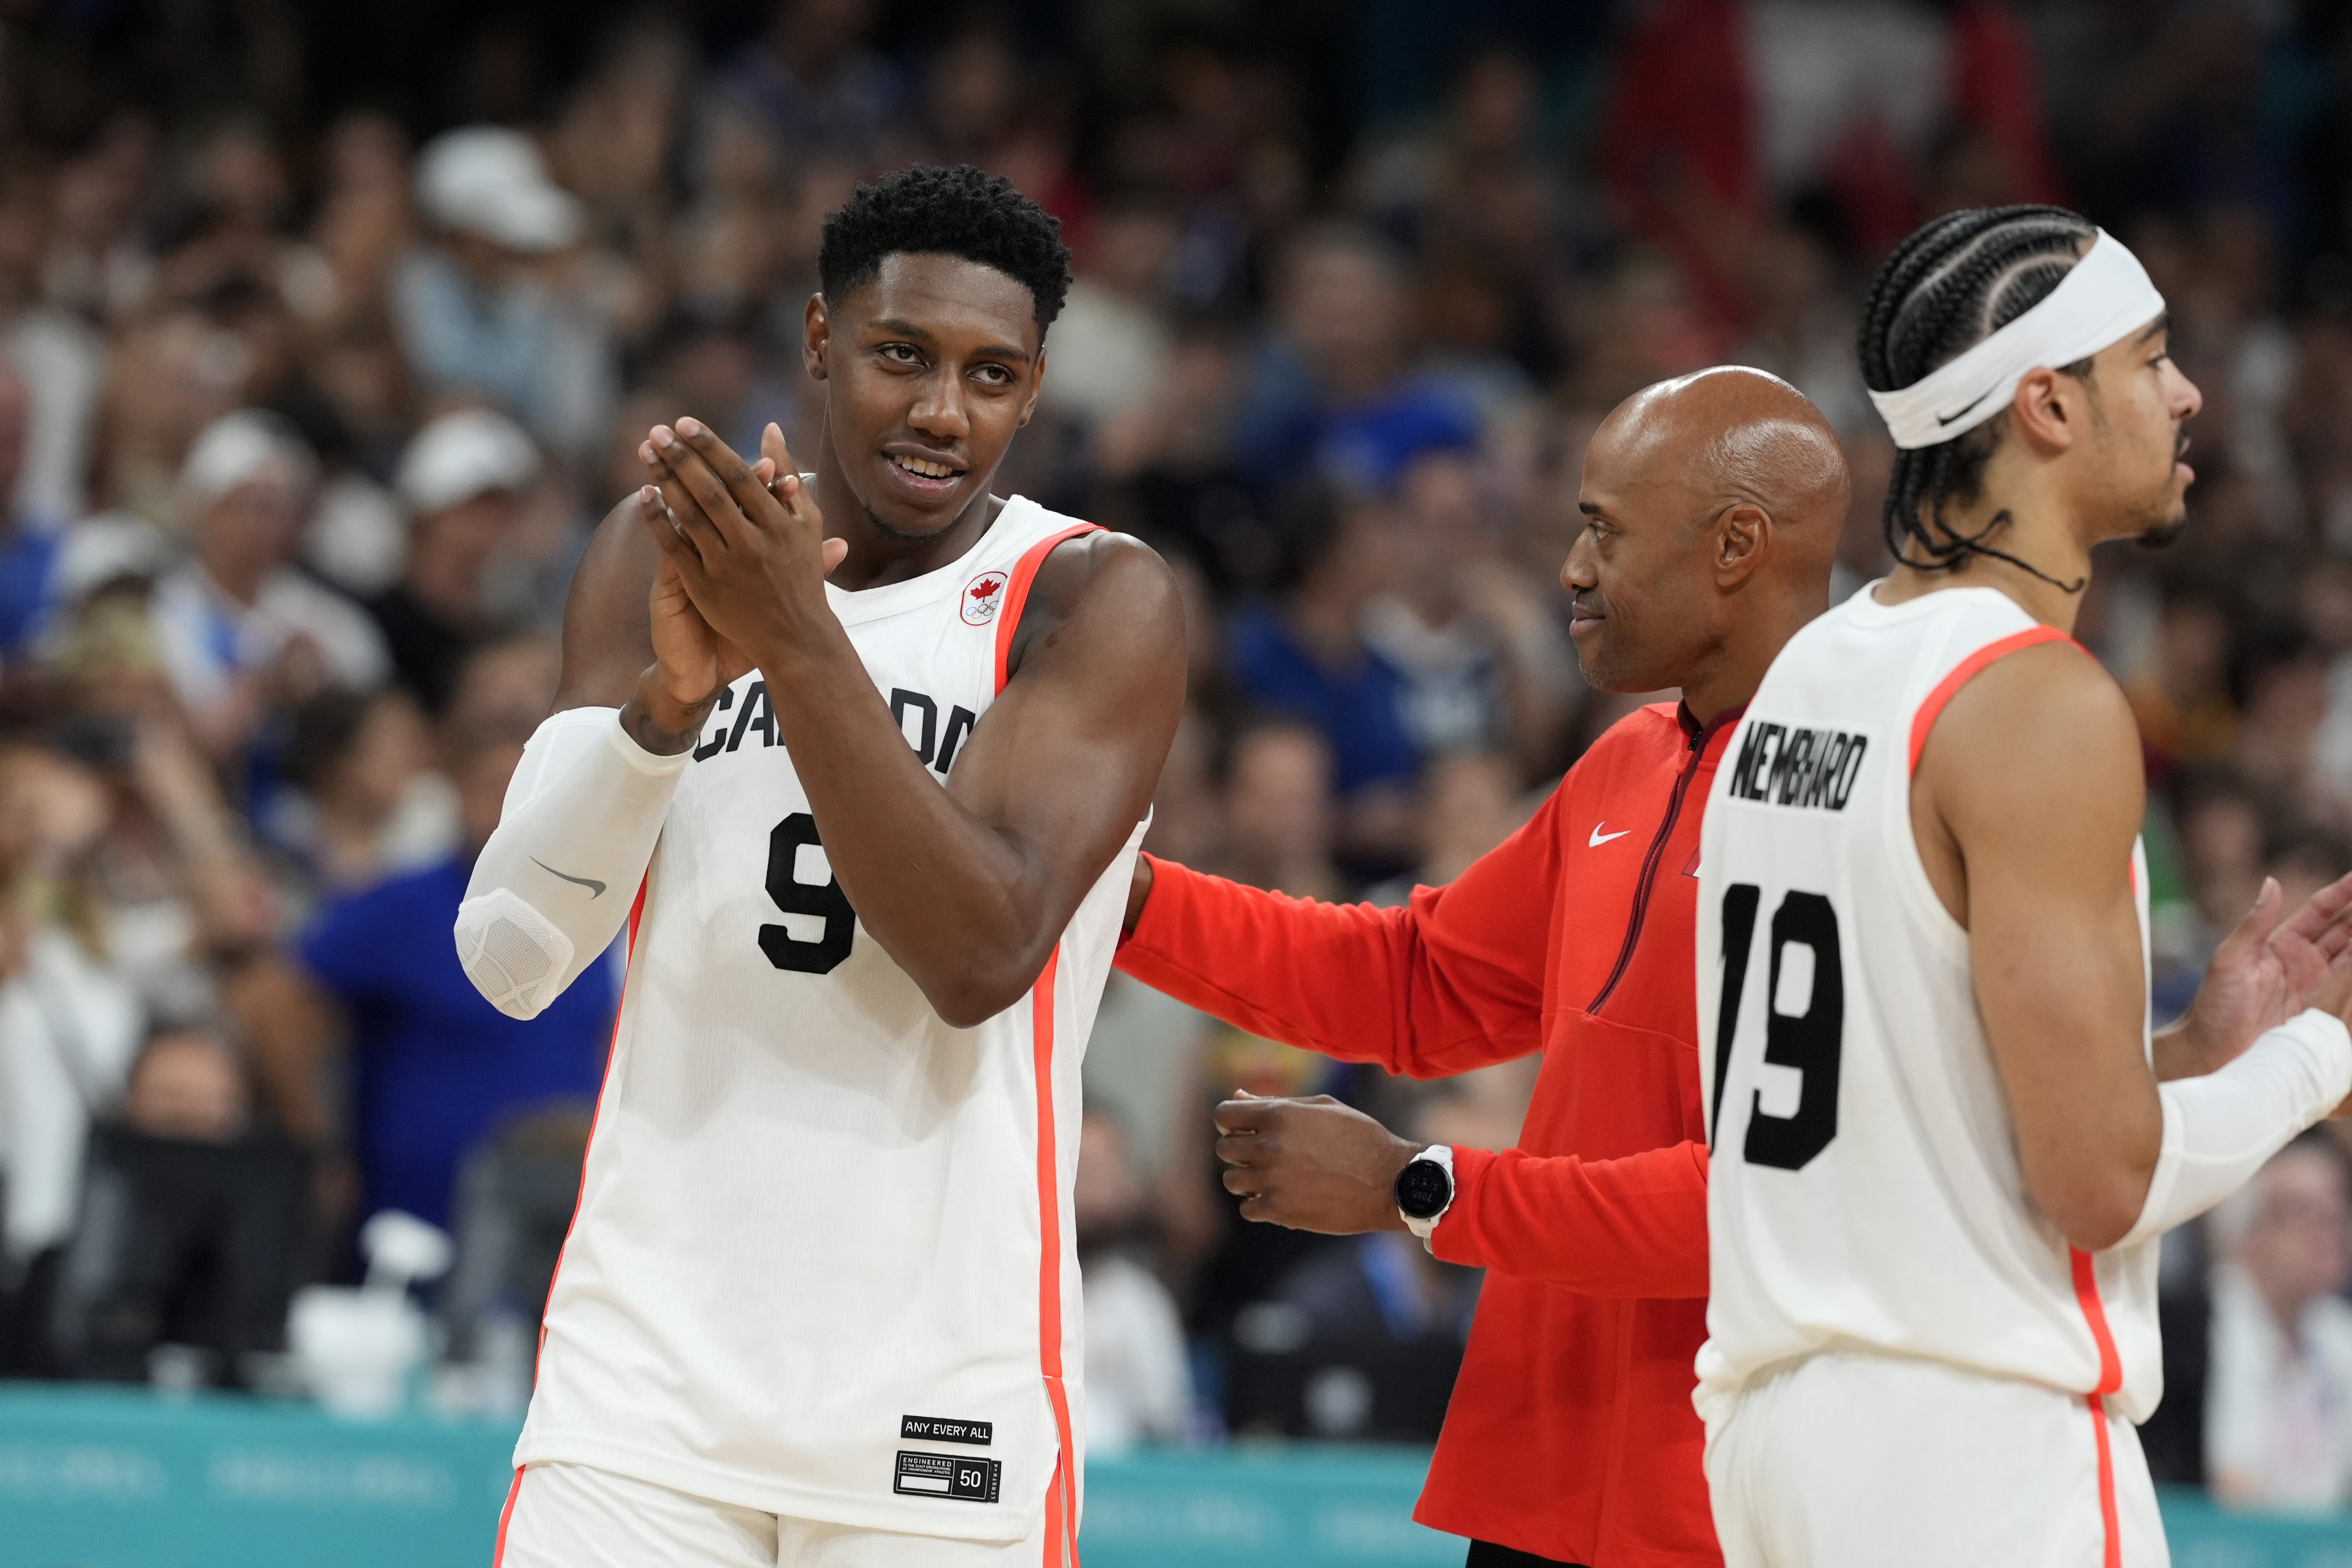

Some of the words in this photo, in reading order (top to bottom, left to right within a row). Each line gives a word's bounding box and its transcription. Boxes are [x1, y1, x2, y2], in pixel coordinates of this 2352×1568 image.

[758, 813, 856, 975] 9
[1708, 882, 1844, 1171] 19
[905, 1421, 930, 1433] ANY
[933, 1424, 967, 1436] EVERY
[970, 1427, 989, 1439] ALL
[903, 1457, 952, 1467] ENGINEERED
[959, 1469, 982, 1488] 50
